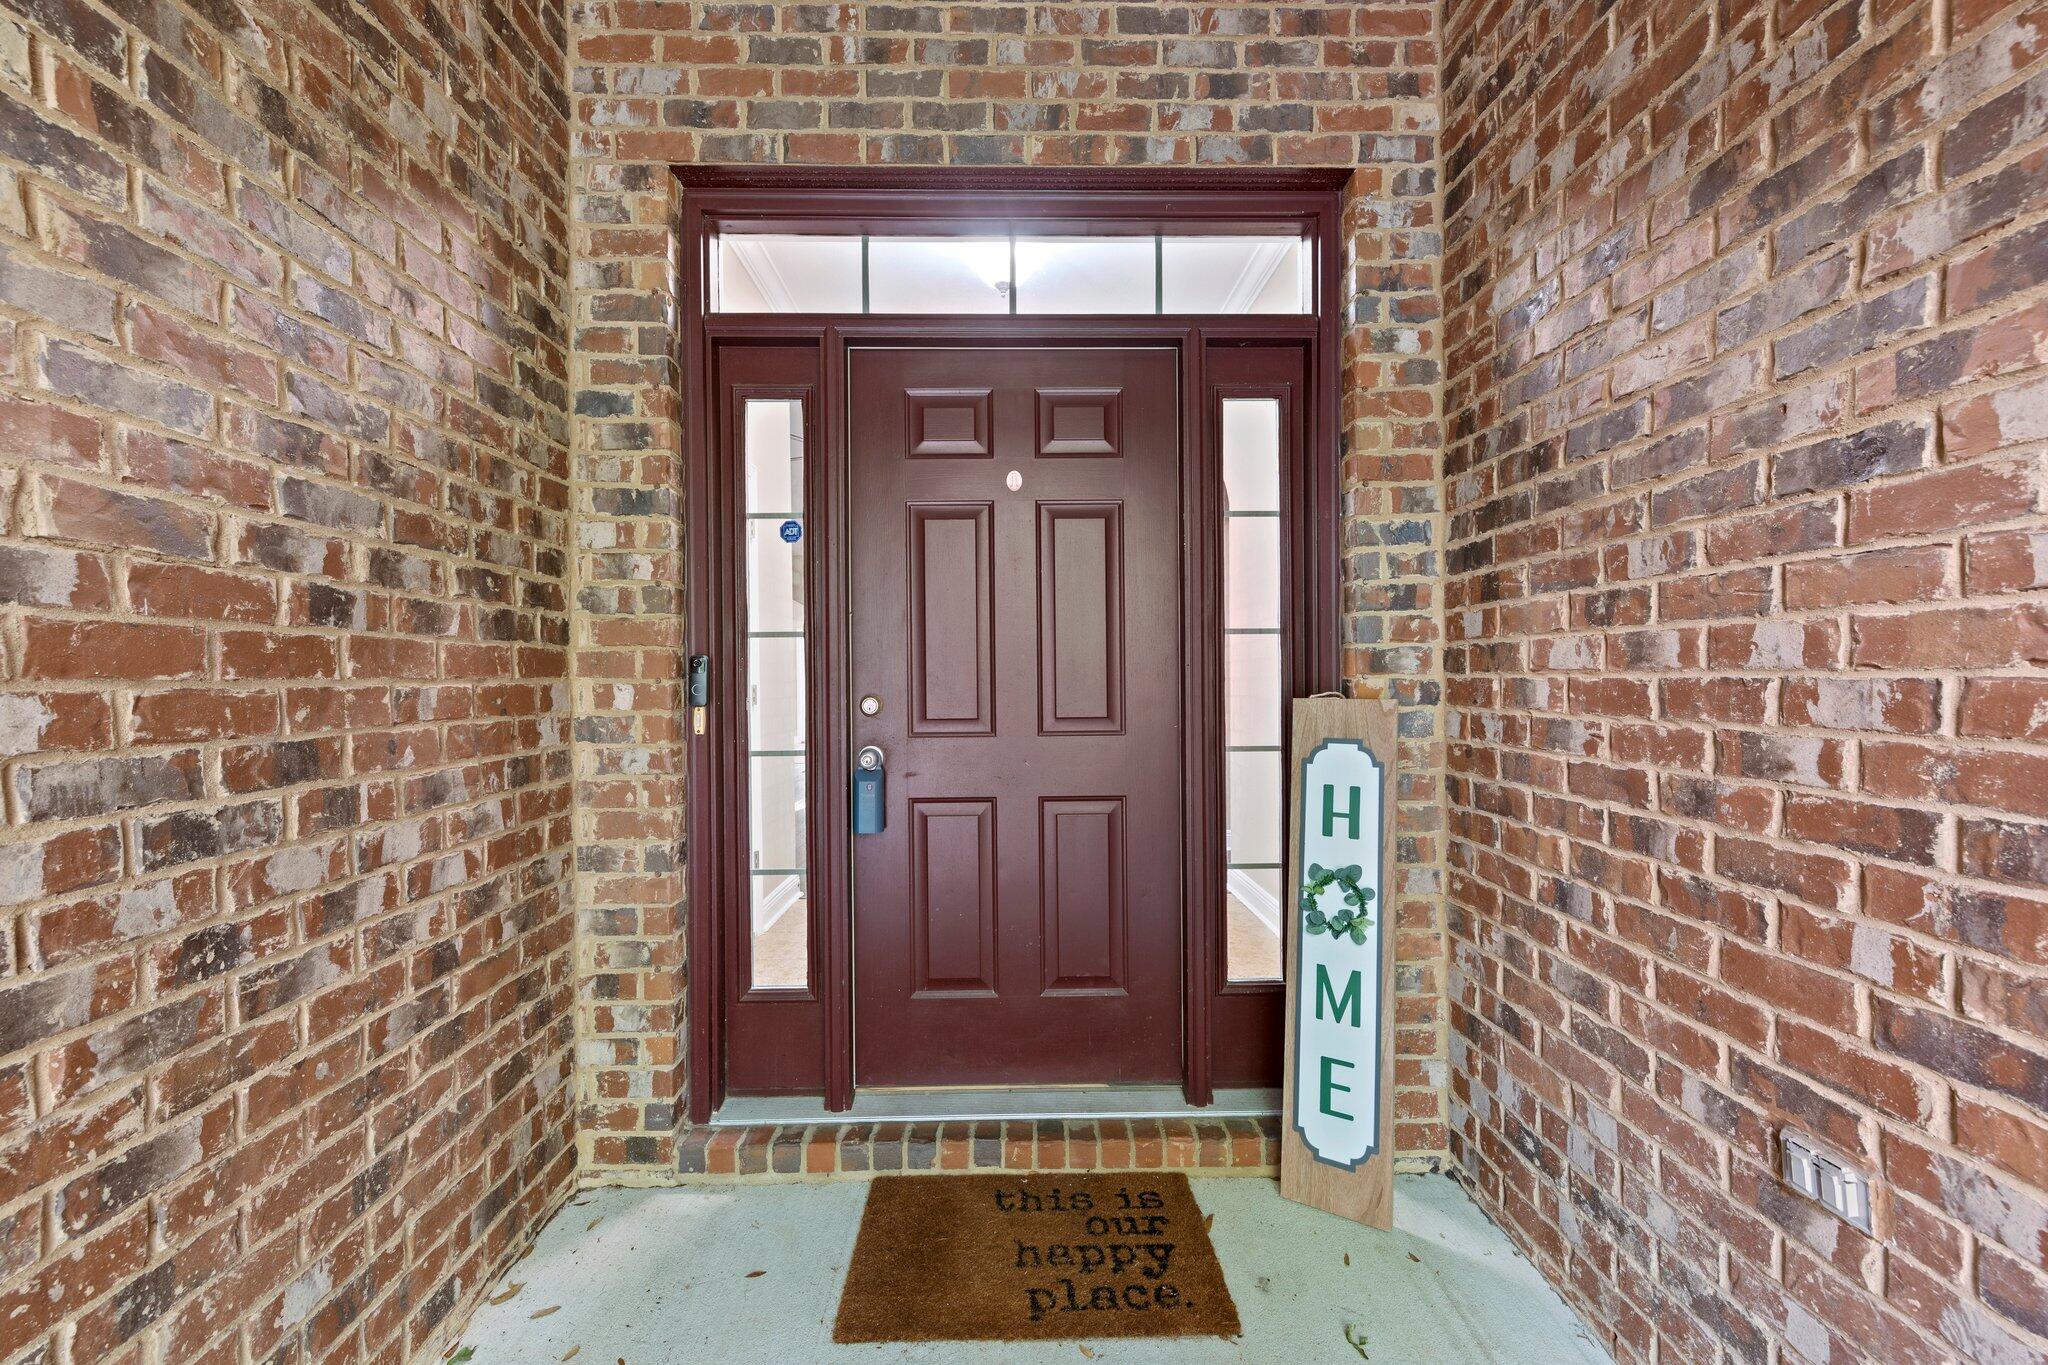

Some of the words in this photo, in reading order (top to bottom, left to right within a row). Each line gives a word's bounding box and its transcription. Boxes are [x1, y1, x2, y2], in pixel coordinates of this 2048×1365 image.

[784, 527, 798, 536] ADT
[994, 1187, 1094, 1213] this
[1114, 1187, 1165, 1212] is
[1085, 1214, 1169, 1237] our
[1013, 1239, 1175, 1279] happy
[1025, 1279, 1193, 1321] place.
